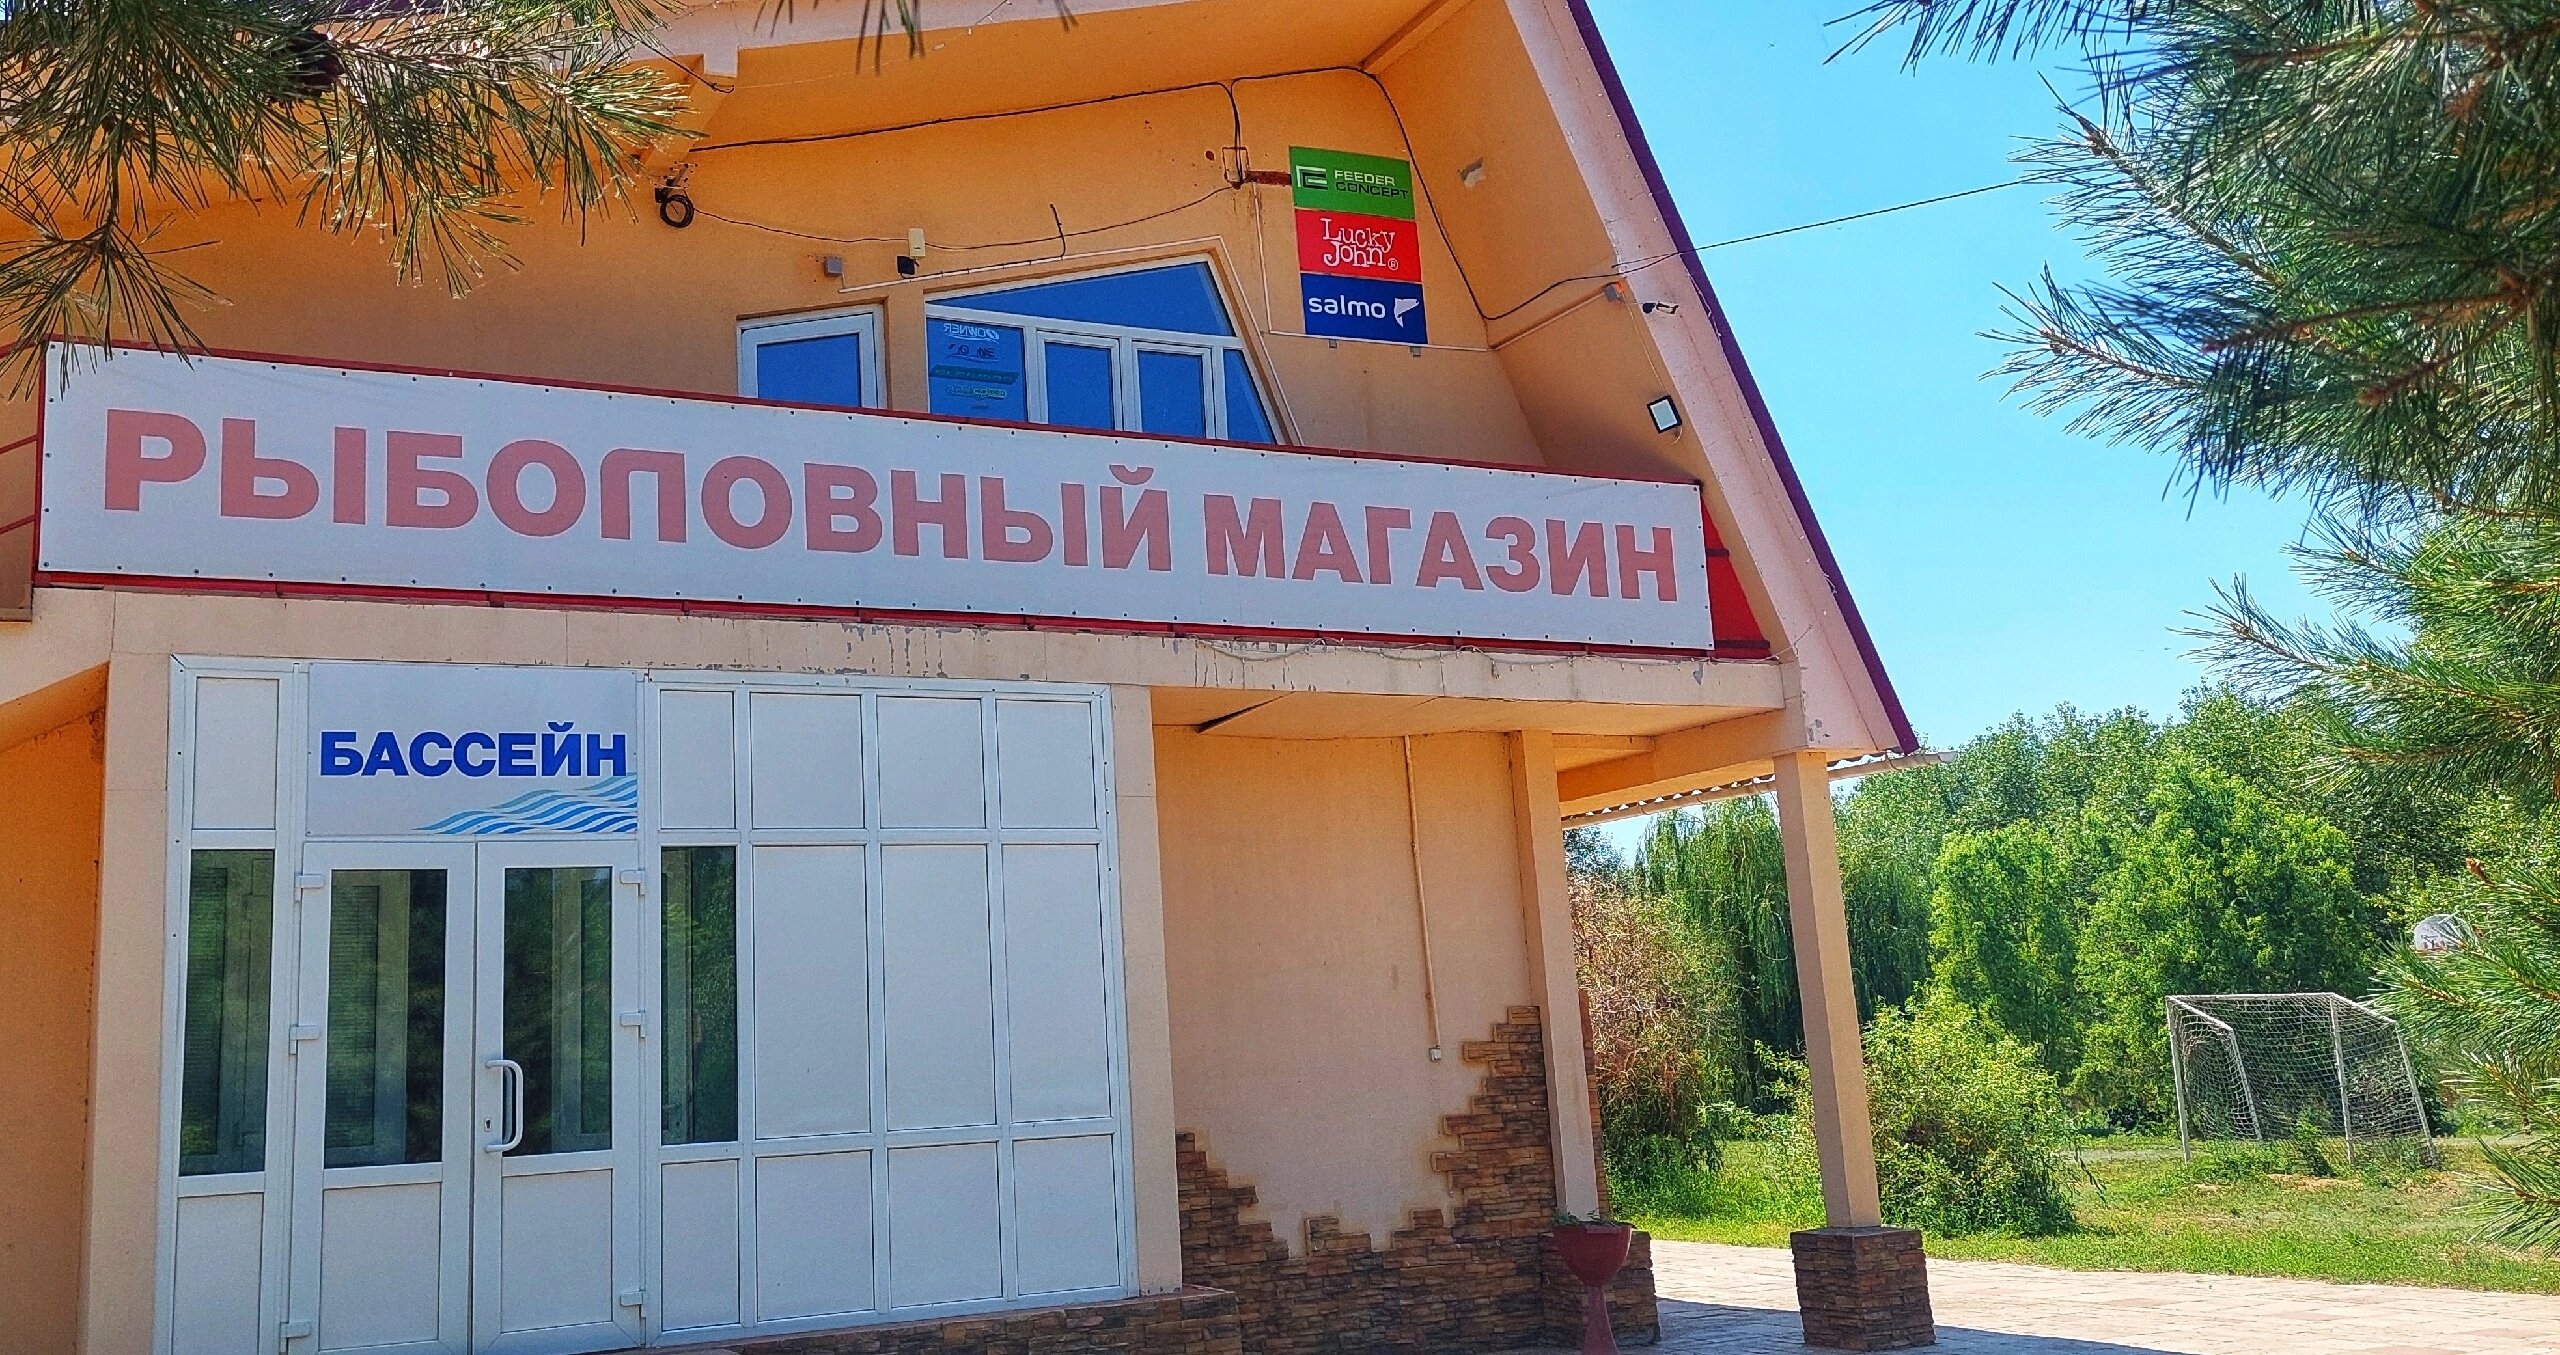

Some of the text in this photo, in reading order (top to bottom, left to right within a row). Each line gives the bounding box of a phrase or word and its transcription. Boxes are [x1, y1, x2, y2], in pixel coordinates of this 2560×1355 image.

[1334, 169, 1395, 186] FEEDER
[1336, 181, 1409, 199] CONCEPT
[1320, 218, 1396, 253] Lucky
[1308, 294, 1386, 319] salmo
[1203, 493, 1678, 602] МАГАЗИН
[320, 721, 627, 777] БАССЕЙН
